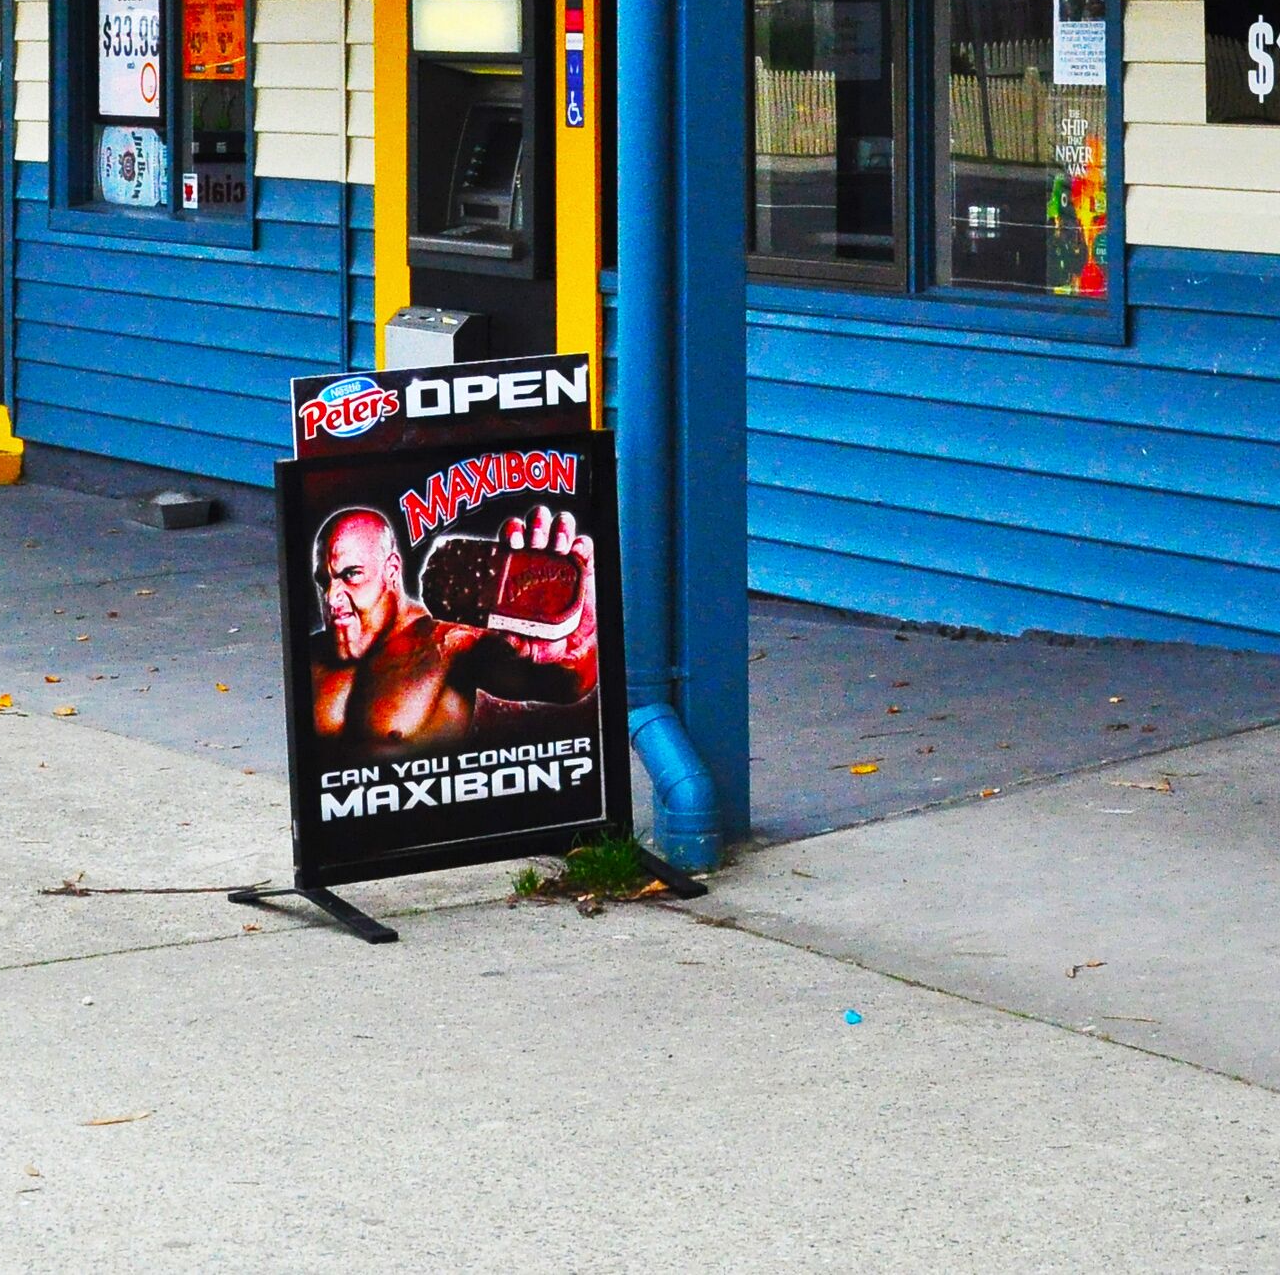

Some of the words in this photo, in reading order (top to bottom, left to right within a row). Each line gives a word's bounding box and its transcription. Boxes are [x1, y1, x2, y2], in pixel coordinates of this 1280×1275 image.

[102, 14, 159, 57] $33.99
[130, 130, 143, 160] JIM
[1061, 118, 1089, 136] SHIP
[1055, 144, 1094, 163] NEVER
[130, 161, 145, 200] BEAM
[298, 387, 401, 441] Peters
[405, 363, 588, 419] OPEN
[399, 449, 579, 547] MAXIBON
[320, 766, 380, 789] CAN
[391, 756, 450, 778] YOU
[457, 737, 592, 770] CONQUER
[320, 757, 593, 822] MAXIBON?
